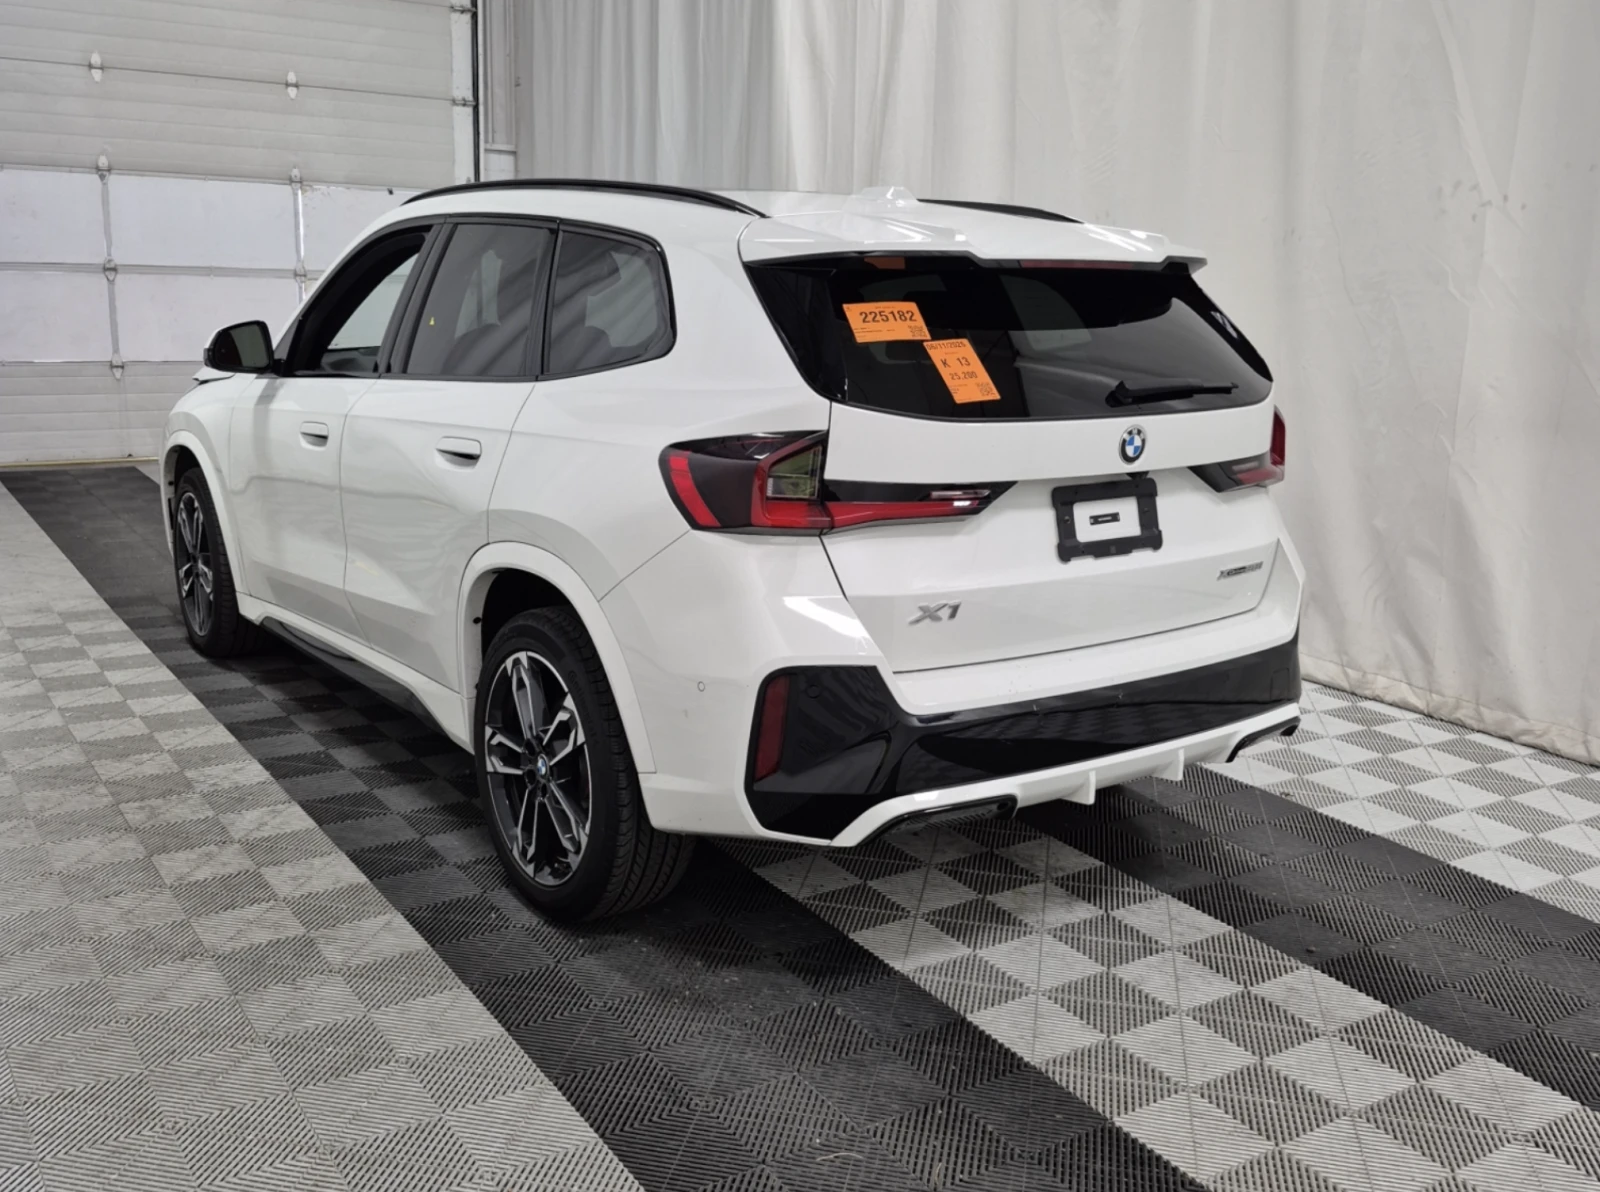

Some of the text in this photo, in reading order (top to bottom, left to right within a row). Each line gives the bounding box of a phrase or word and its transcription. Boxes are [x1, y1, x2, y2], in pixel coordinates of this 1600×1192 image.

[859, 310, 917, 324] 225182
[940, 356, 971, 368] K 13
[908, 602, 961, 626] X1
